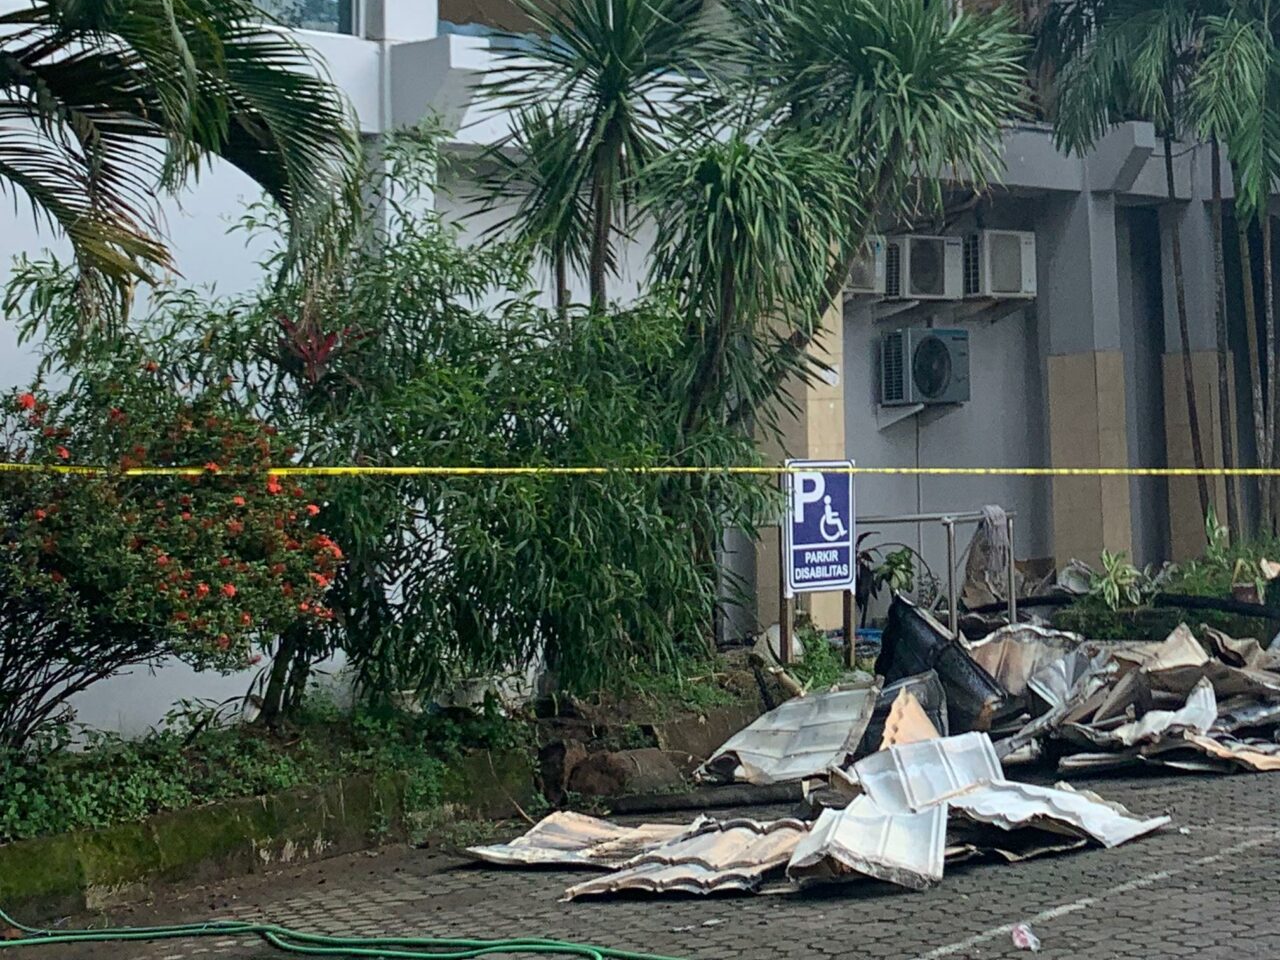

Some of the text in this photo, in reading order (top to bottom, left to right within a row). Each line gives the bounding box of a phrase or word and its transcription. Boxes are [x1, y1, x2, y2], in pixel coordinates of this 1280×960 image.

[794, 471, 825, 523] P
[805, 550, 838, 564] PARKIR
[795, 564, 848, 580] DISABILITAS
